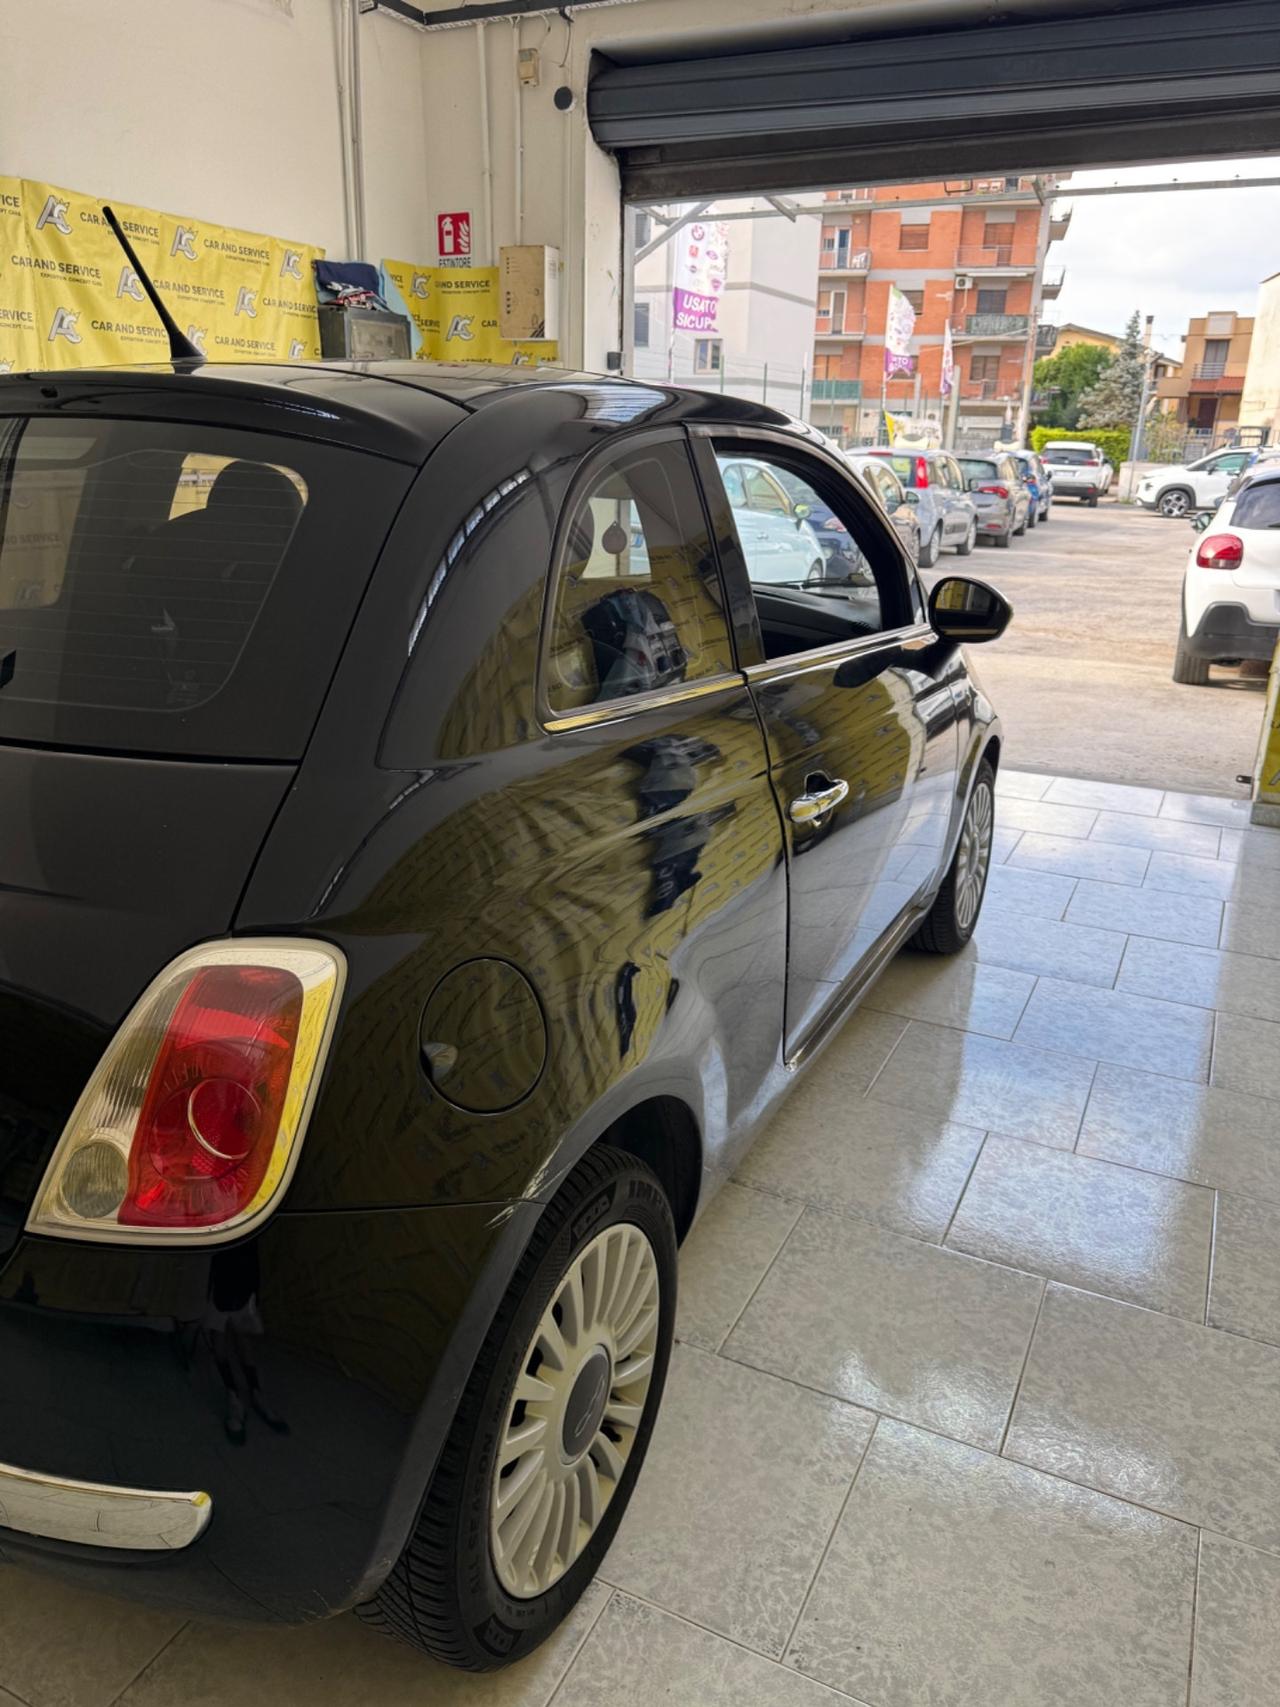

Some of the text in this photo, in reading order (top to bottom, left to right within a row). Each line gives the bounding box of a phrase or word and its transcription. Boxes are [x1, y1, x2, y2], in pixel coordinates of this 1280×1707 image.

[79, 211, 99, 225] CAR
[122, 221, 159, 238] SERVICE
[203, 239, 270, 260] CAR AND SERVICE
[11, 255, 101, 279] CAR AND SERVICE
[152, 279, 225, 299] CAR AND SERVICE
[454, 279, 491, 289] SERVICE
[262, 298, 277, 306] CAR
[294, 301, 316, 314] SERVIC
[683, 293, 717, 314] USATO
[91, 319, 167, 338] CAR AND SERVIC
[481, 319, 498, 328] CAR
[214, 336, 276, 351] CAR AND SERVICE
